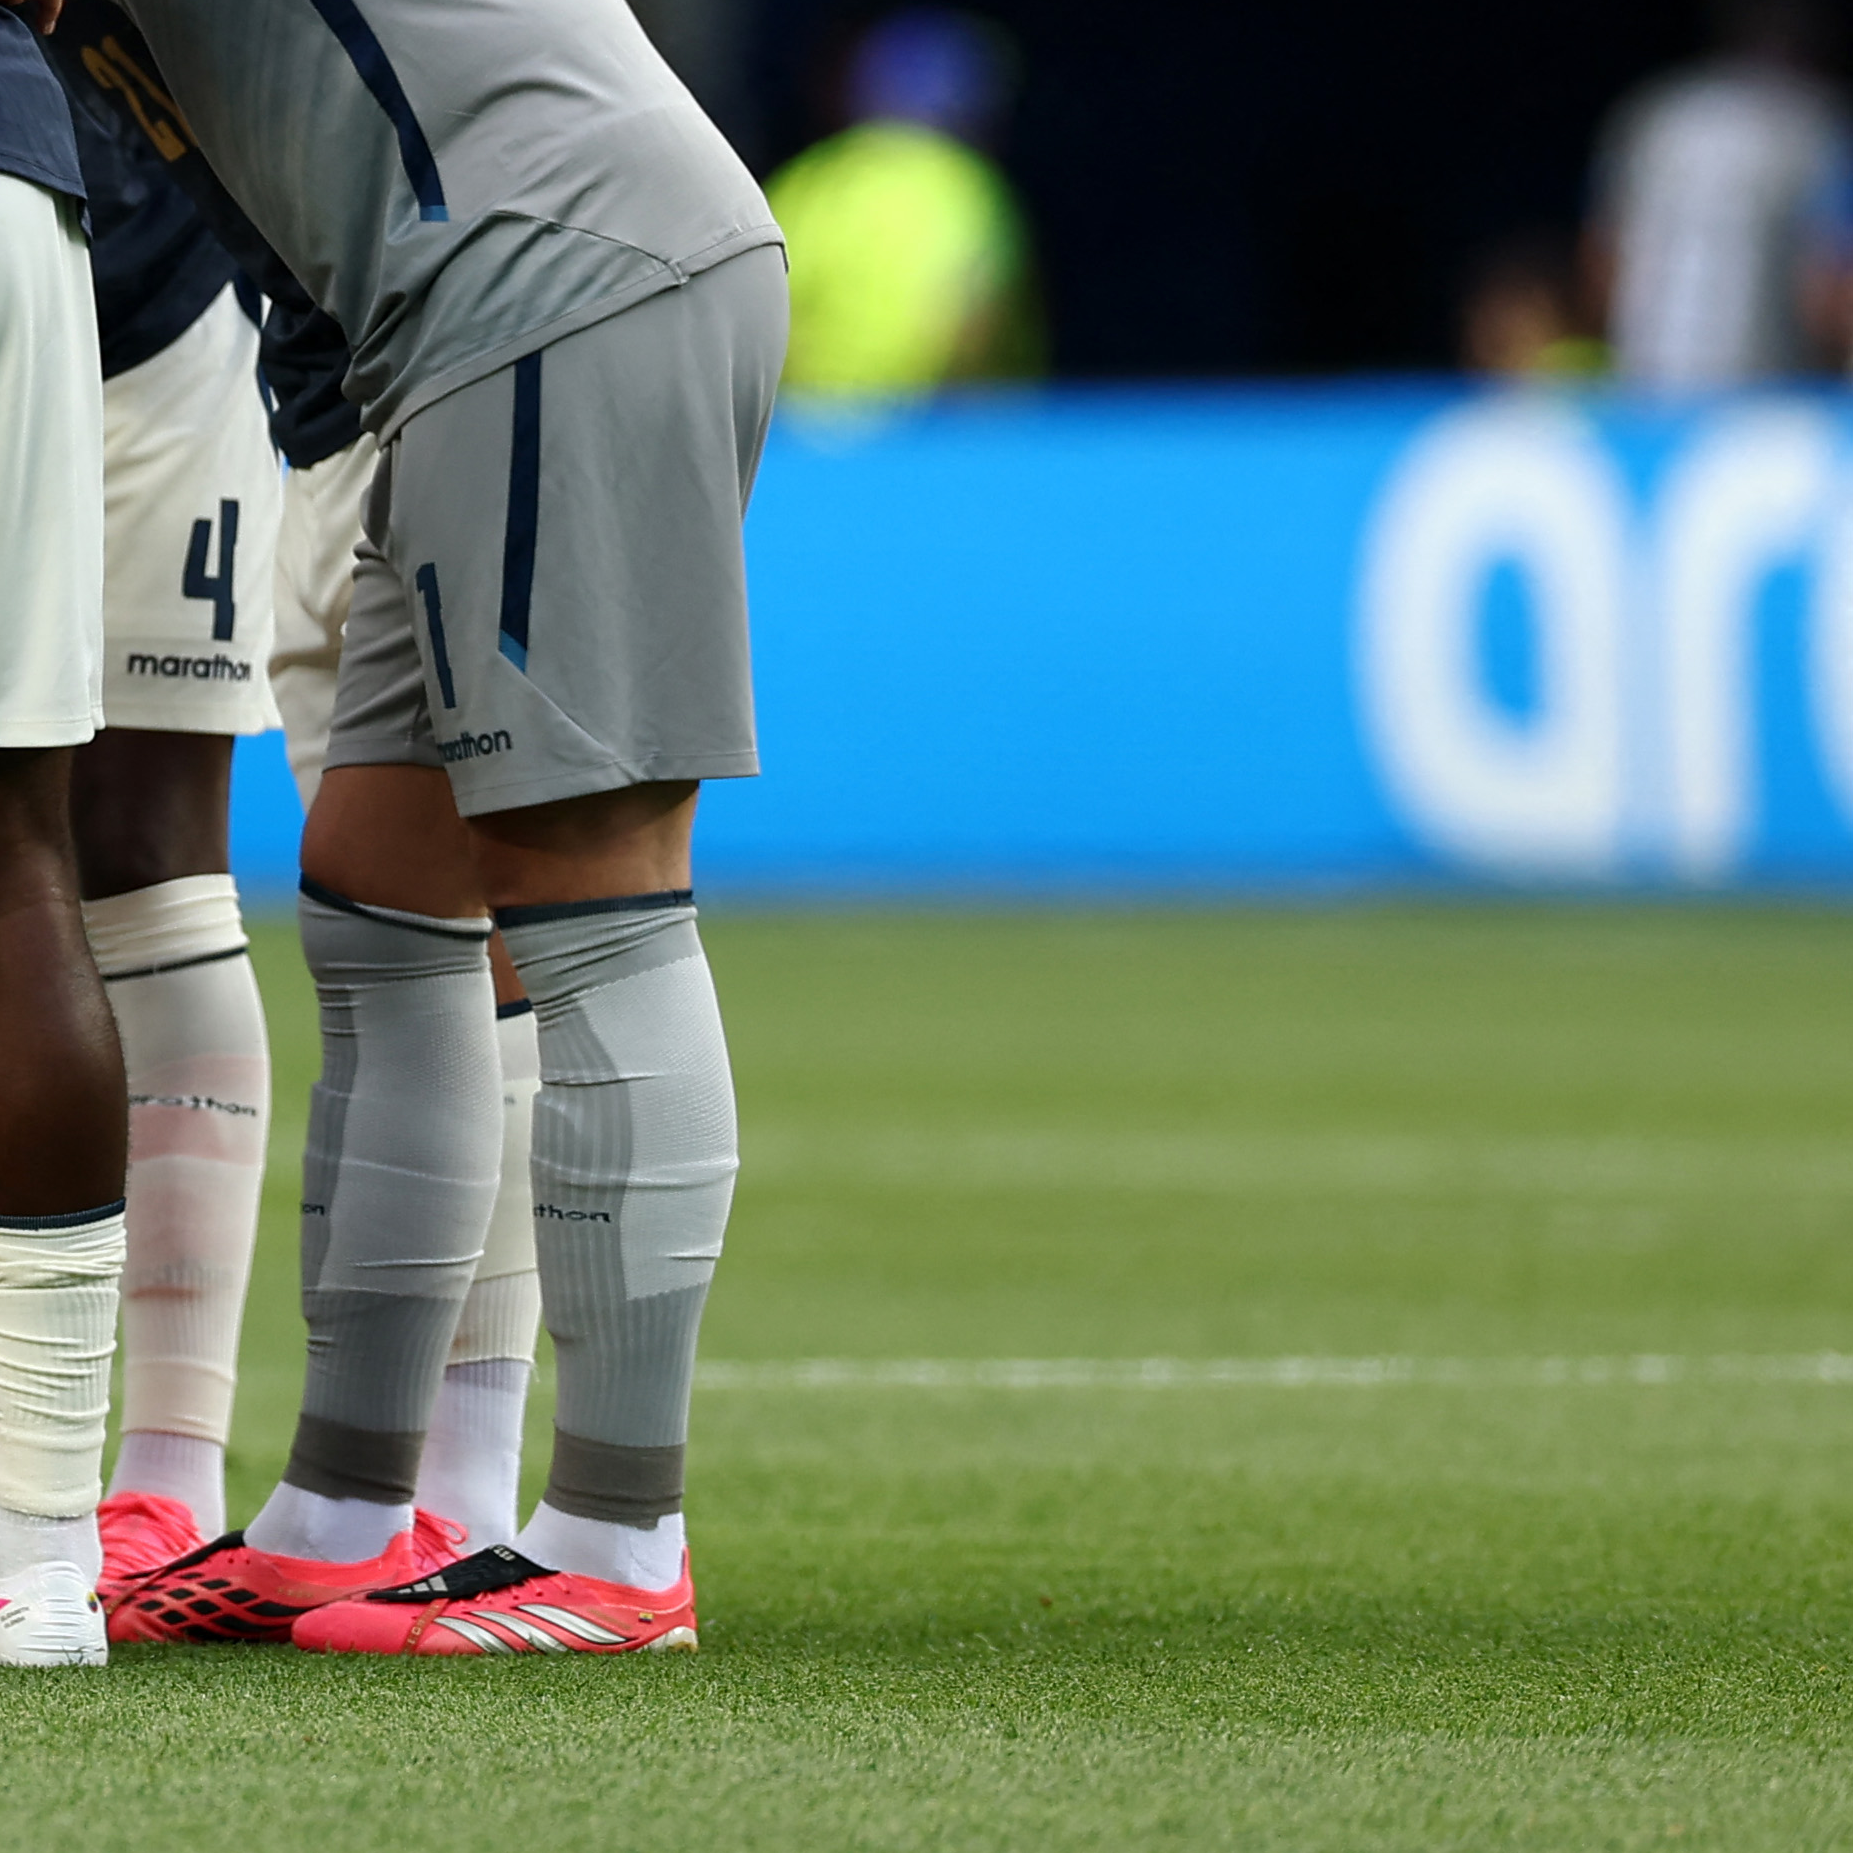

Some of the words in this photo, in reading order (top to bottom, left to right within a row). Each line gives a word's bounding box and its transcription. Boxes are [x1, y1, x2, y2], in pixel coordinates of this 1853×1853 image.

[182, 498, 239, 641] 4
[415, 561, 457, 709] 1
[1352, 392, 1853, 889] ar
